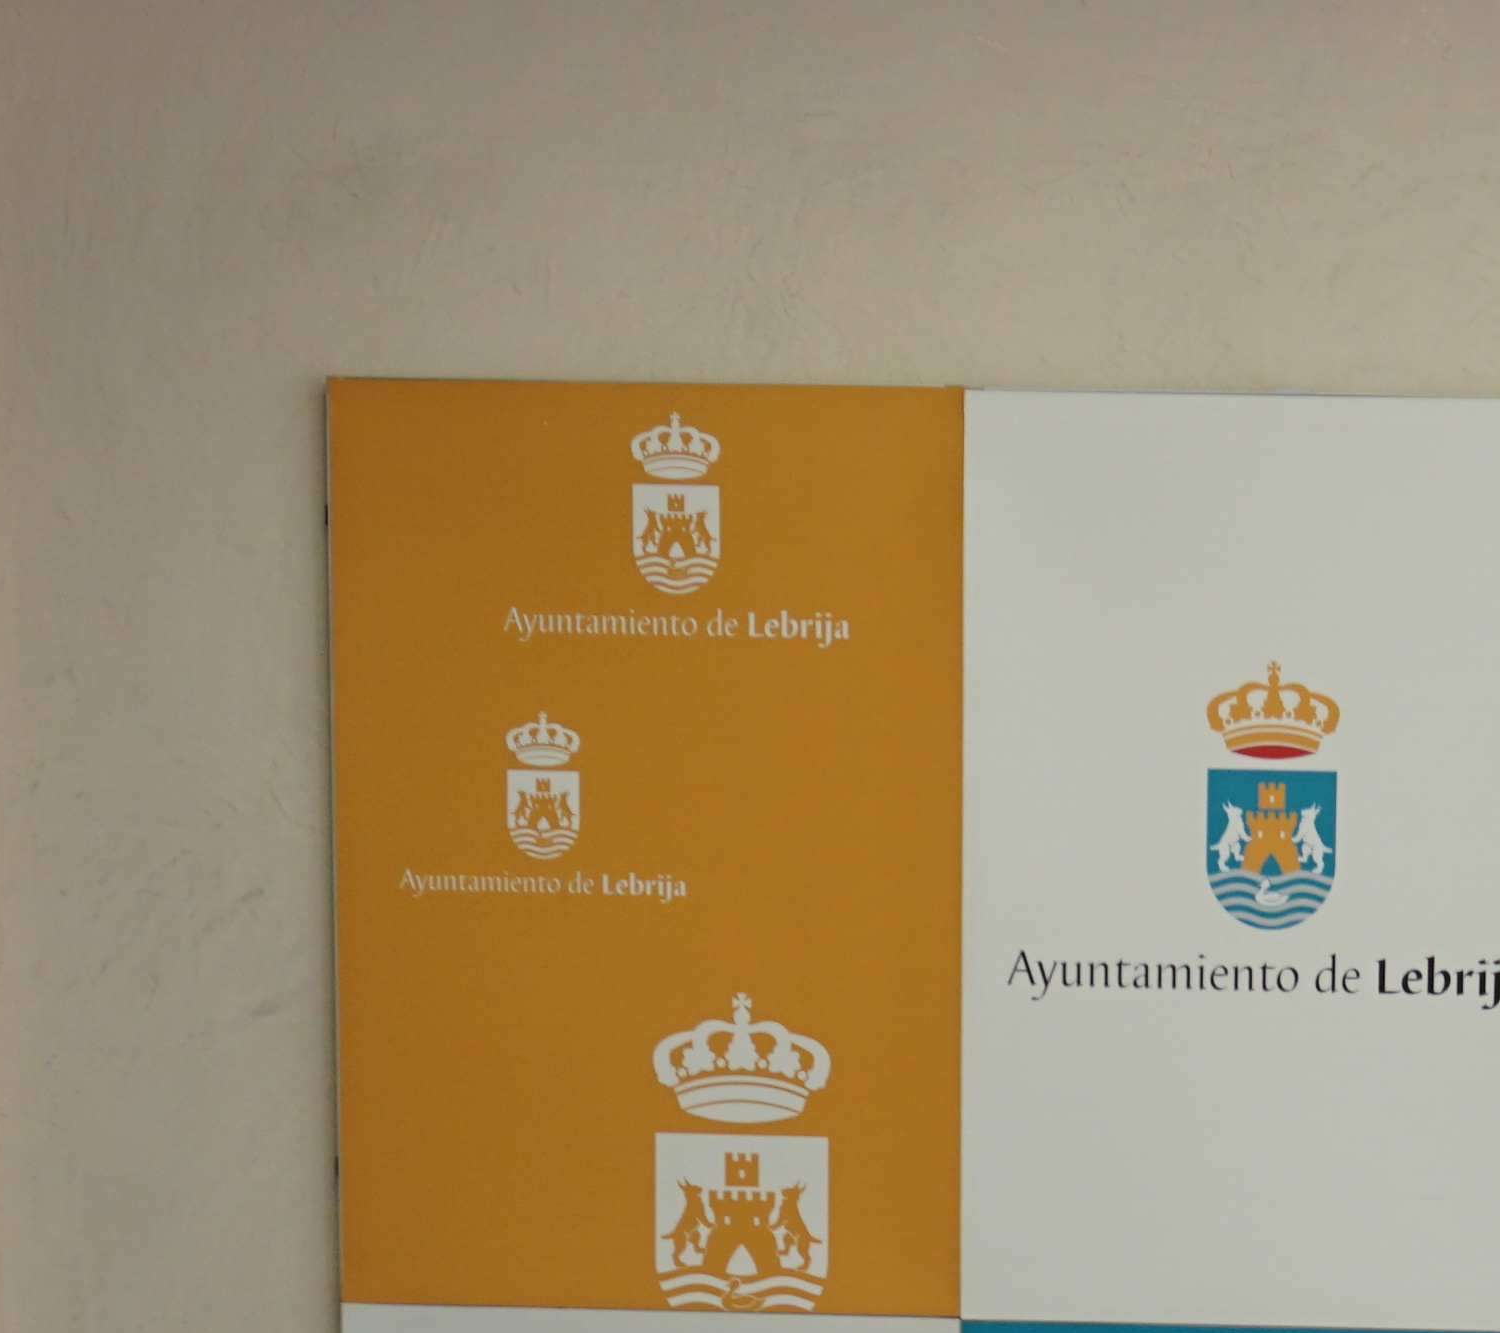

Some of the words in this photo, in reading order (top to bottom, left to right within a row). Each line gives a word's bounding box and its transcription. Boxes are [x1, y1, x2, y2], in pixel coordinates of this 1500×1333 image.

[503, 606, 698, 641] Ayuntamiento
[706, 607, 739, 637] de
[747, 609, 850, 649] Lebrija
[400, 868, 562, 897] Ayuntamiento
[567, 871, 595, 895] de
[601, 871, 687, 905] Lebrija
[1007, 949, 1299, 1001] Ayuntamiento
[1314, 953, 1361, 994] de
